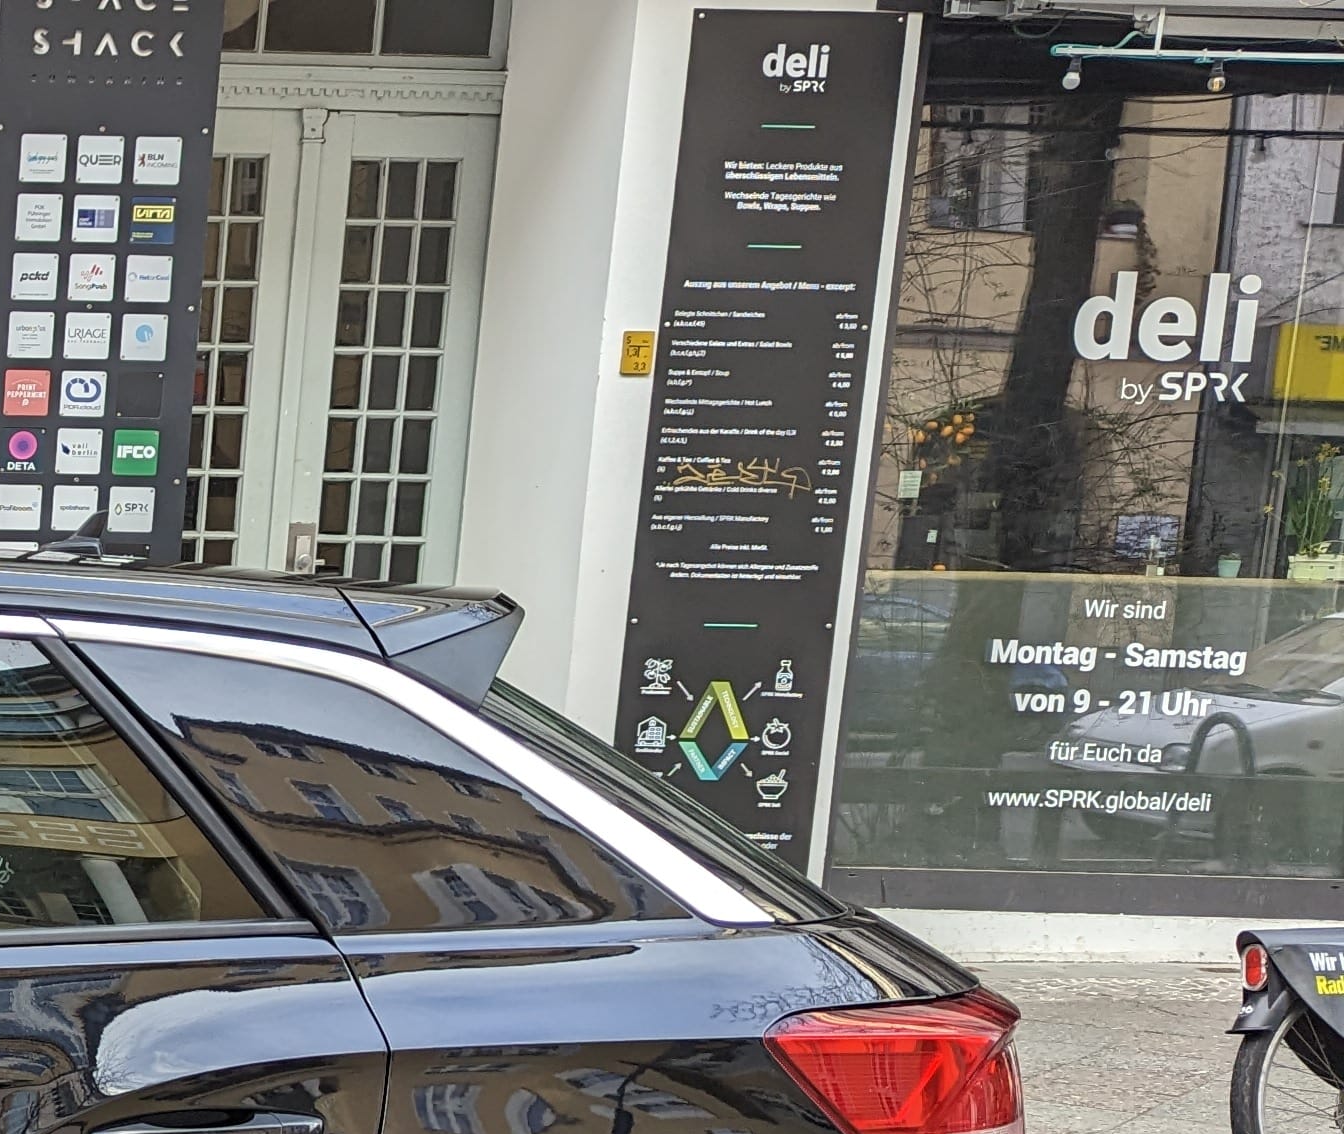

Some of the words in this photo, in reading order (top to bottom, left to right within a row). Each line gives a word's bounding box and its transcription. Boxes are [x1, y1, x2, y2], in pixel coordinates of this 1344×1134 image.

[763, 43, 831, 78] deli
[779, 84, 792, 94] by
[793, 80, 825, 93] SPRK
[20, 271, 50, 282] pckd
[74, 283, 108, 291] SongPush
[1073, 271, 1262, 362] deli
[1120, 378, 1154, 405] by
[1158, 371, 1249, 402] SPRK
[116, 445, 157, 459] IFCO
[6, 462, 36, 471] DETA
[1085, 600, 1118, 618] Wir
[1123, 600, 1167, 620] sind
[990, 639, 1097, 672] Montag
[1124, 642, 1247, 675] Samstag
[1015, 692, 1065, 713] von
[1074, 689, 1091, 714] 9
[1118, 691, 1151, 715] 21
[1162, 691, 1212, 717] Uhr
[1049, 741, 1077, 761] für
[1083, 743, 1132, 762] Euch
[1137, 744, 1162, 763] da
[988, 789, 1212, 814] www.SPRK.global/deli
[1309, 952, 1337, 971] Wir
